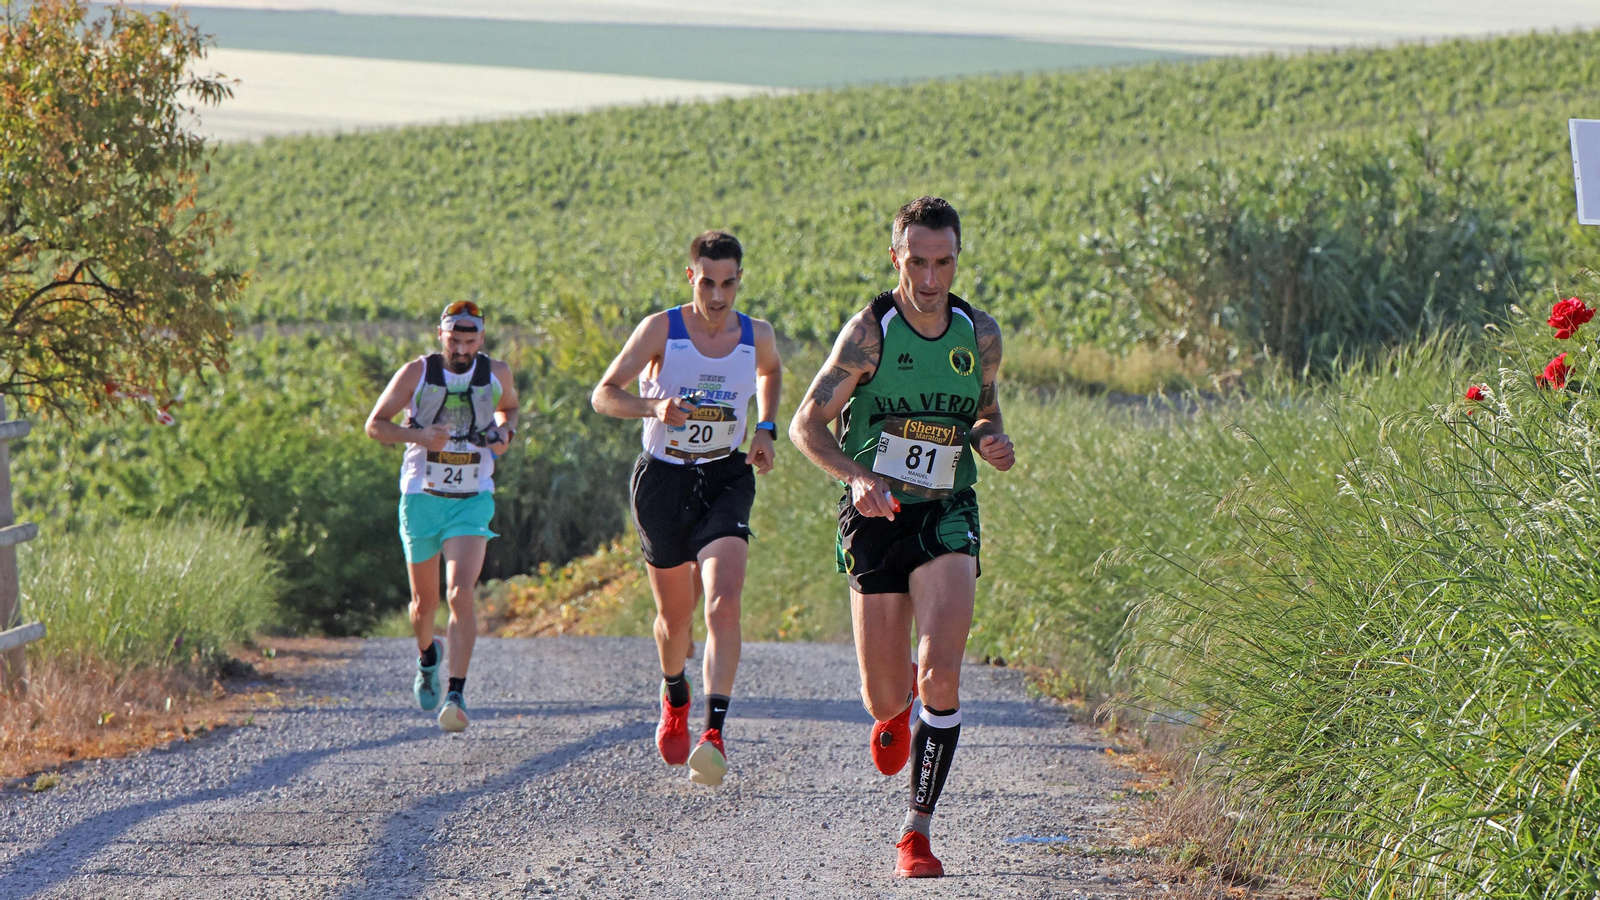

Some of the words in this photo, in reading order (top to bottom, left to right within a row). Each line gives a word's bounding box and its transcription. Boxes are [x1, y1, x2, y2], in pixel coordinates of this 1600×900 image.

[688, 424, 713, 444] 20
[909, 421, 952, 442] Sherry
[905, 444, 938, 475] 81
[443, 467, 463, 485] 24
[907, 470, 929, 480] MANUEL
